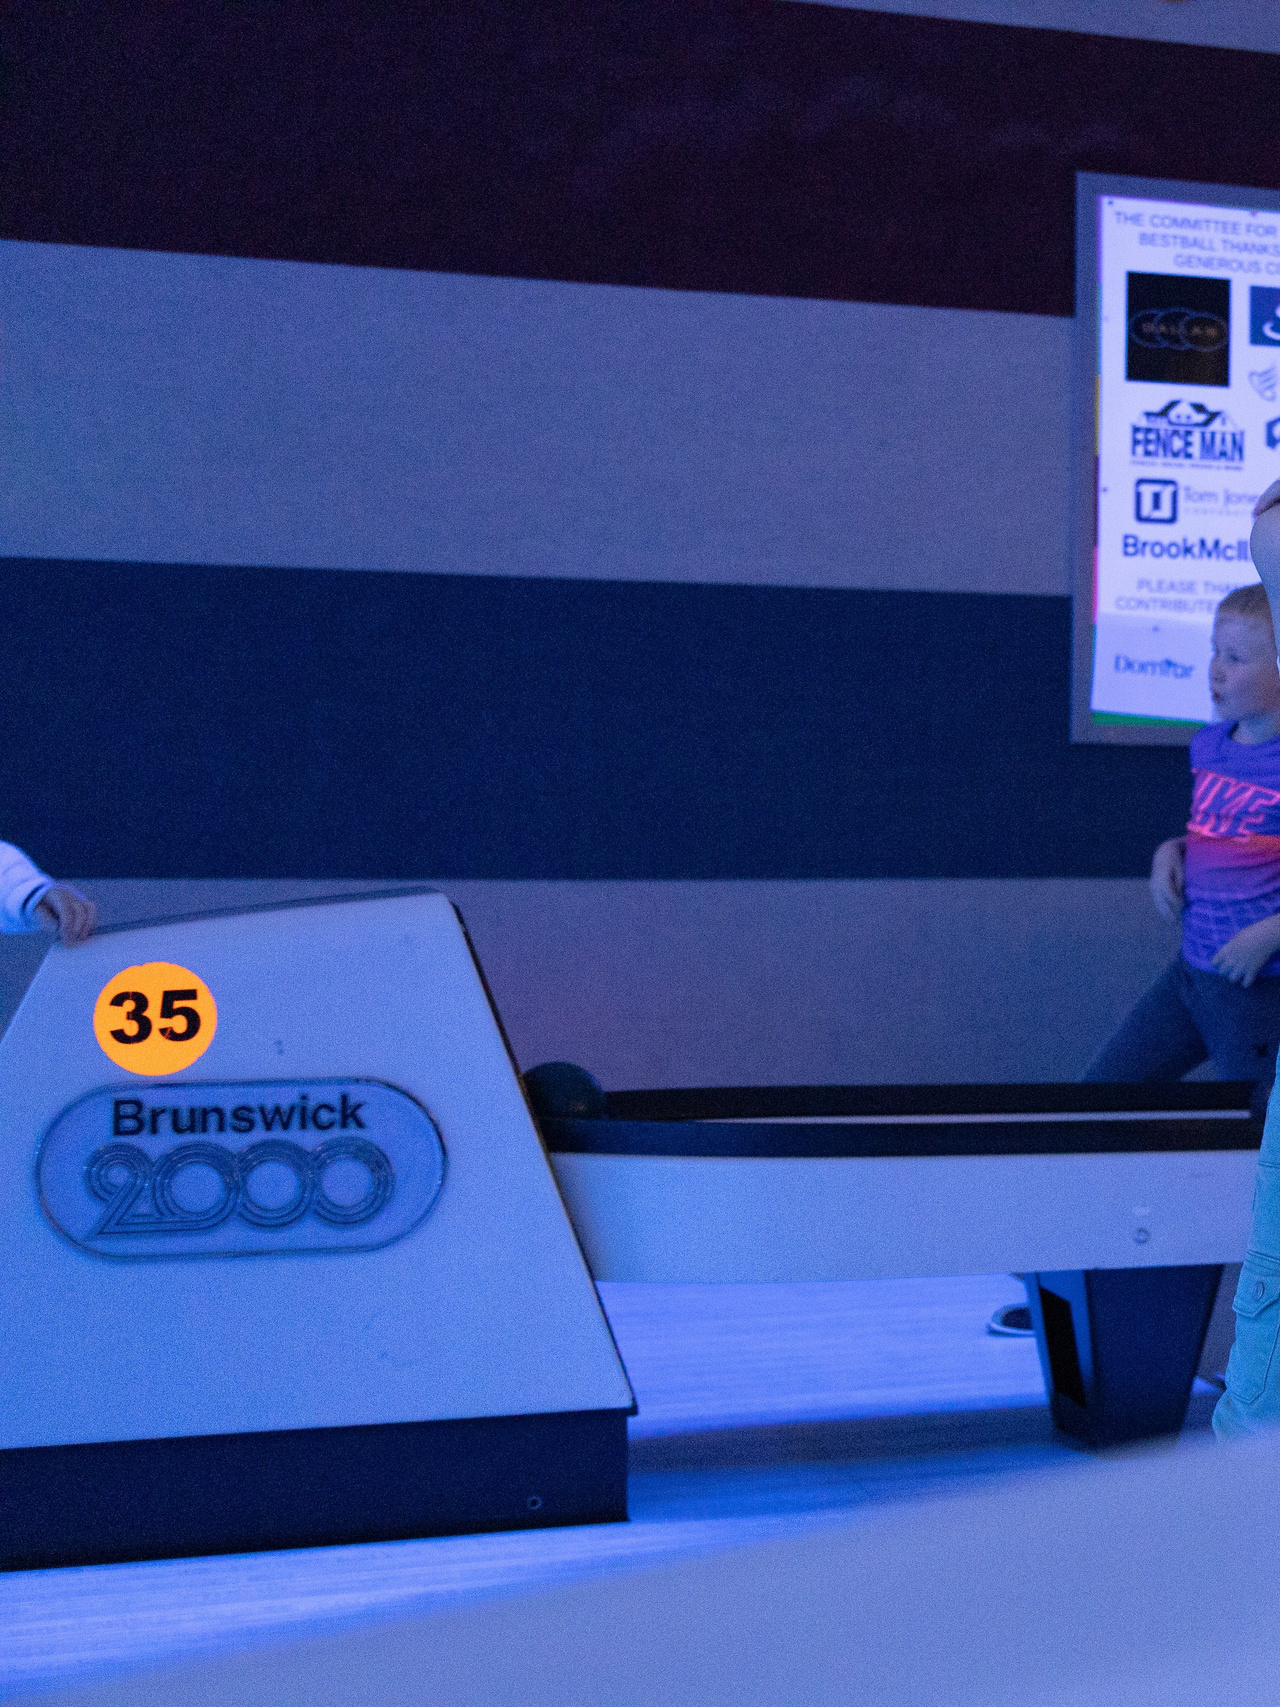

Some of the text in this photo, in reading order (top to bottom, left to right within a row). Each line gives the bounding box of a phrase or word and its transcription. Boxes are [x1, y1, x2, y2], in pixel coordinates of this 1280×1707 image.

[1115, 211, 1145, 227] THE
[1150, 213, 1240, 237] COMMITTEE
[1246, 224, 1277, 238] FOR
[1138, 232, 1216, 253] BESTBALL
[1173, 253, 1262, 274] GENEROUS
[1131, 425, 1245, 463] FENCE MAN
[1136, 579, 1197, 594] PLEASE
[109, 988, 202, 1045] 35
[111, 1094, 368, 1136] Brunswick
[86, 1137, 395, 1237] 2000
